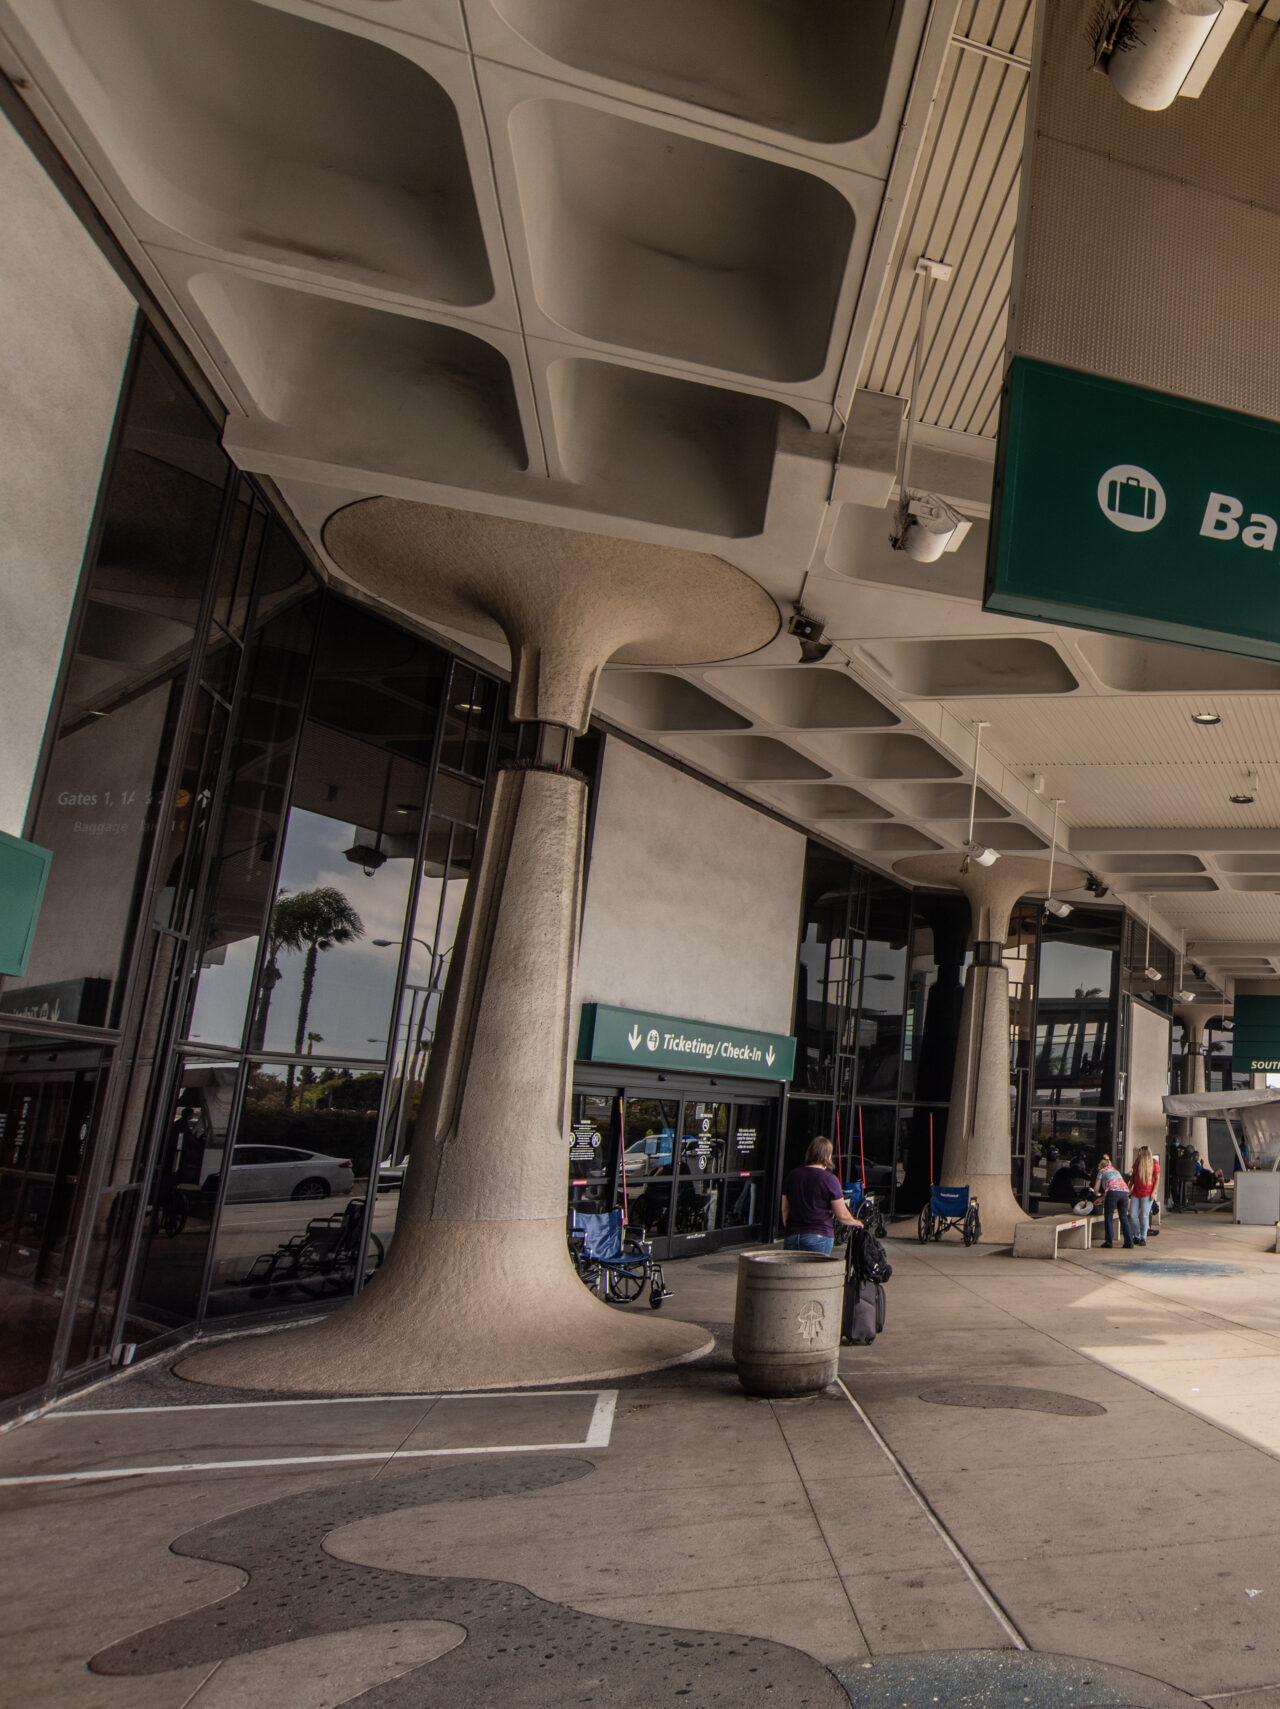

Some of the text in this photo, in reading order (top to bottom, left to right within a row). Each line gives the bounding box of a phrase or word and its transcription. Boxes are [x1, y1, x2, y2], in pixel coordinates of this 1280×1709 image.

[57, 791, 98, 806] Gates
[104, 791, 113, 808] 1,
[73, 820, 128, 836] Baggage
[663, 1033, 714, 1059] Ticketing
[720, 1042, 762, 1062] Check-In
